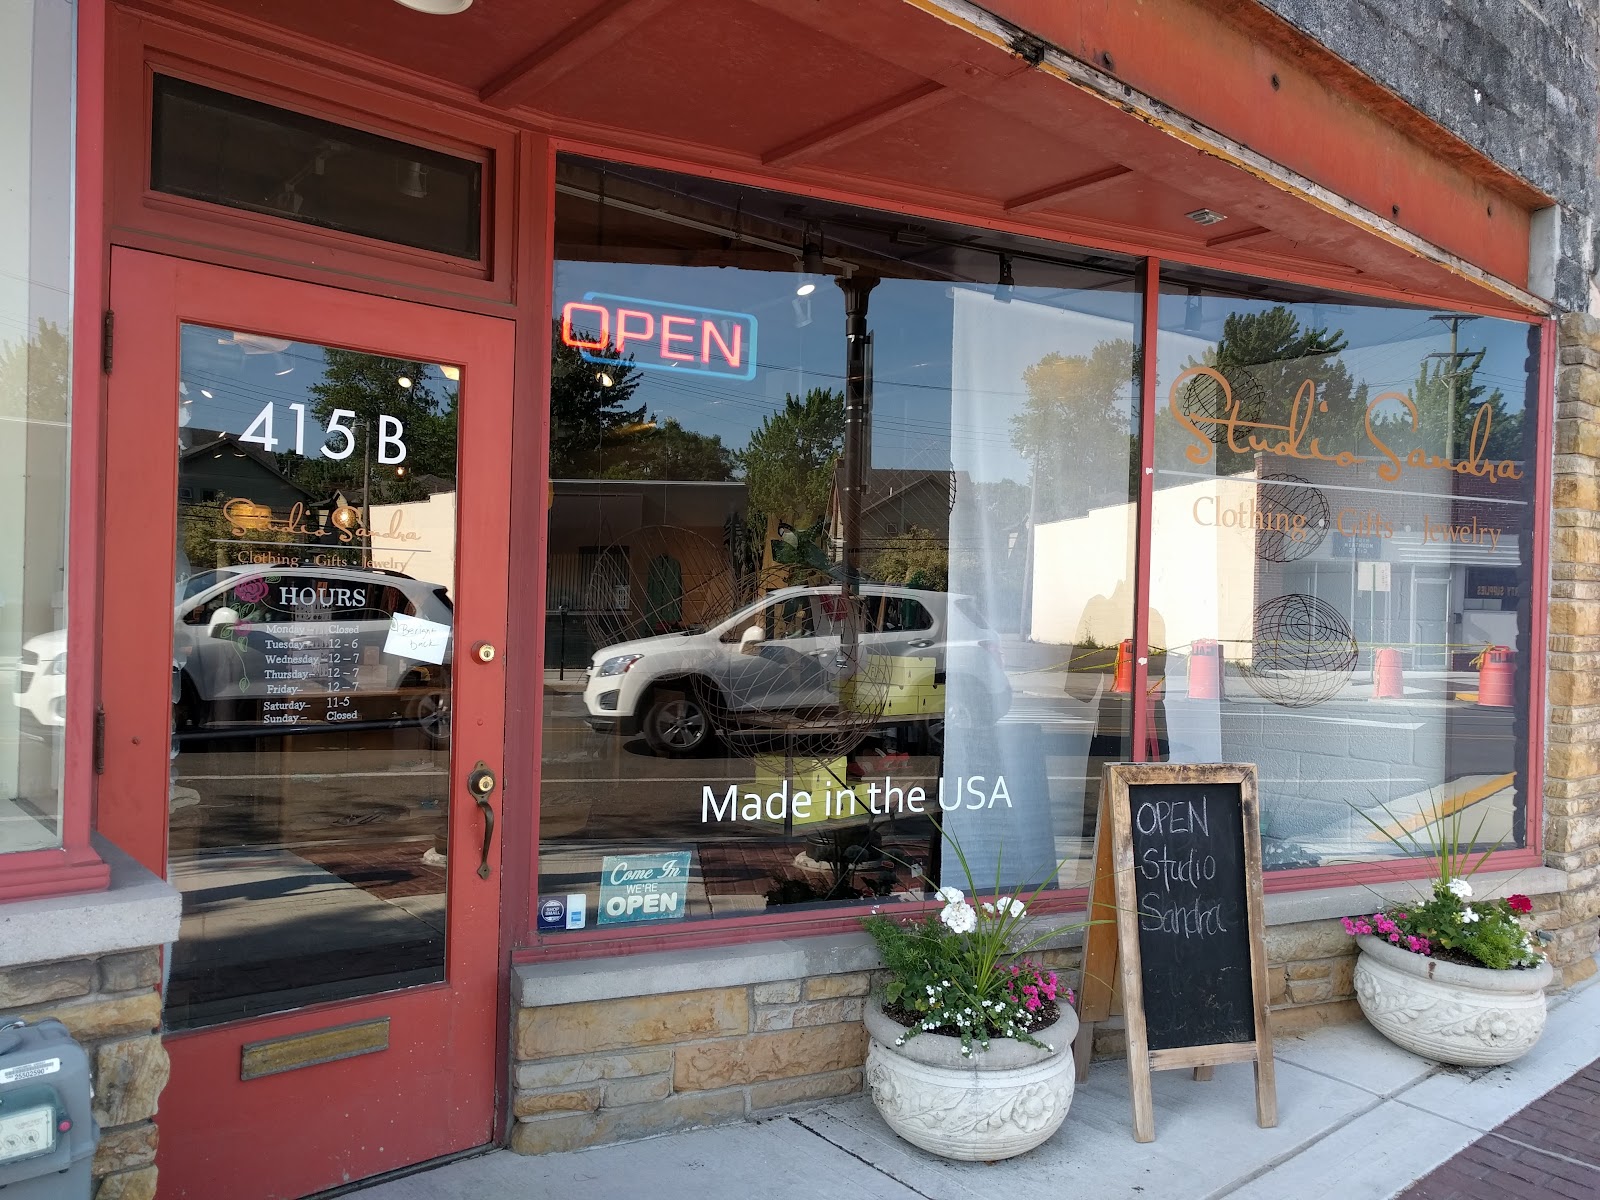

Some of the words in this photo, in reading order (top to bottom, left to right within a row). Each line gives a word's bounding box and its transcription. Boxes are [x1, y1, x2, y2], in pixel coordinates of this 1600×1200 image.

[562, 302, 742, 368] OPEN
[238, 401, 357, 461] 415
[377, 415, 408, 466] B
[1168, 366, 1367, 464] Studio
[1364, 392, 1524, 484] Sandra
[223, 498, 332, 537] Studio
[331, 506, 422, 542] Sandra
[1192, 495, 1308, 543] Clothing
[1336, 508, 1395, 539] Gifts
[1422, 514, 1502, 553] Jewelry
[238, 551, 300, 568] Clothing
[315, 553, 348, 567] Gifts
[361, 556, 410, 572] Jewelry
[279, 586, 366, 608] HOURS
[265, 624, 305, 635] Monday
[328, 624, 360, 634] Closed
[265, 639, 305, 650] Tuesday
[328, 639, 341, 649] 12
[263, 713, 300, 725] Sunday
[326, 710, 358, 721] Closed
[701, 779, 813, 823] Made
[824, 781, 856, 817] in
[866, 776, 926, 815] the
[938, 775, 1014, 811] USA
[1136, 796, 1210, 837] OPEN
[610, 861, 654, 886] Come
[656, 859, 682, 879] In
[626, 882, 659, 895] WE'RE
[1140, 845, 1216, 893] Studio
[606, 892, 678, 917] OPEN
[1141, 892, 1228, 939] Sandra
